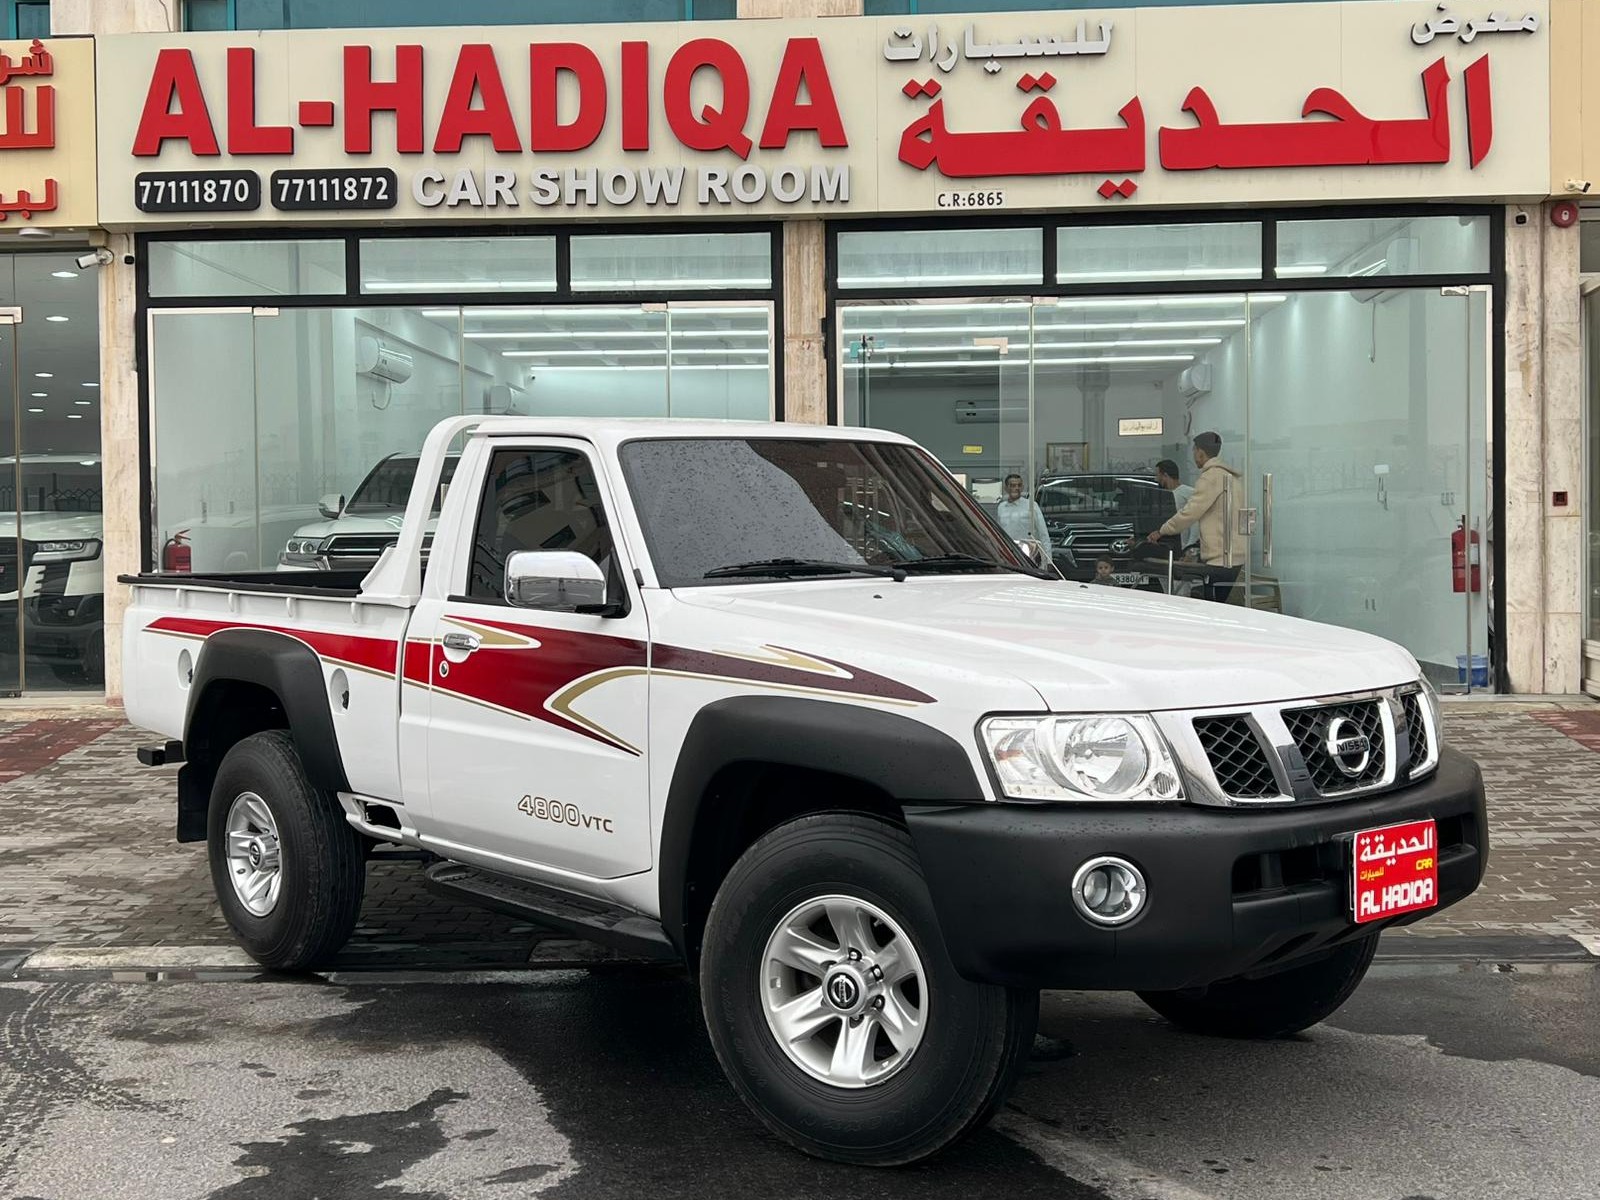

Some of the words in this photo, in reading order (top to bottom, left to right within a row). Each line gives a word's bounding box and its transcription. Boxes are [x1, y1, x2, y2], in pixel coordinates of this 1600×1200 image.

[1410, 3, 1540, 44] معرض
[884, 18, 1114, 73] للسيارات
[132, 38, 848, 160] AL-HADIQA
[898, 53, 1493, 199] الحديقة
[139, 179, 250, 204] 77111870
[277, 176, 389, 201] 77111872
[412, 167, 519, 207] CAR
[529, 165, 685, 205] SHOW
[699, 164, 850, 203] ROOM
[938, 192, 1004, 208] C.R:6865
[518, 795, 580, 827] 4800
[582, 814, 613, 833] VTC
[1360, 827, 1433, 866] الحديقة
[1416, 858, 1433, 870] CAR
[1361, 890, 1380, 916] AL
[1382, 878, 1433, 911] HADIQA
